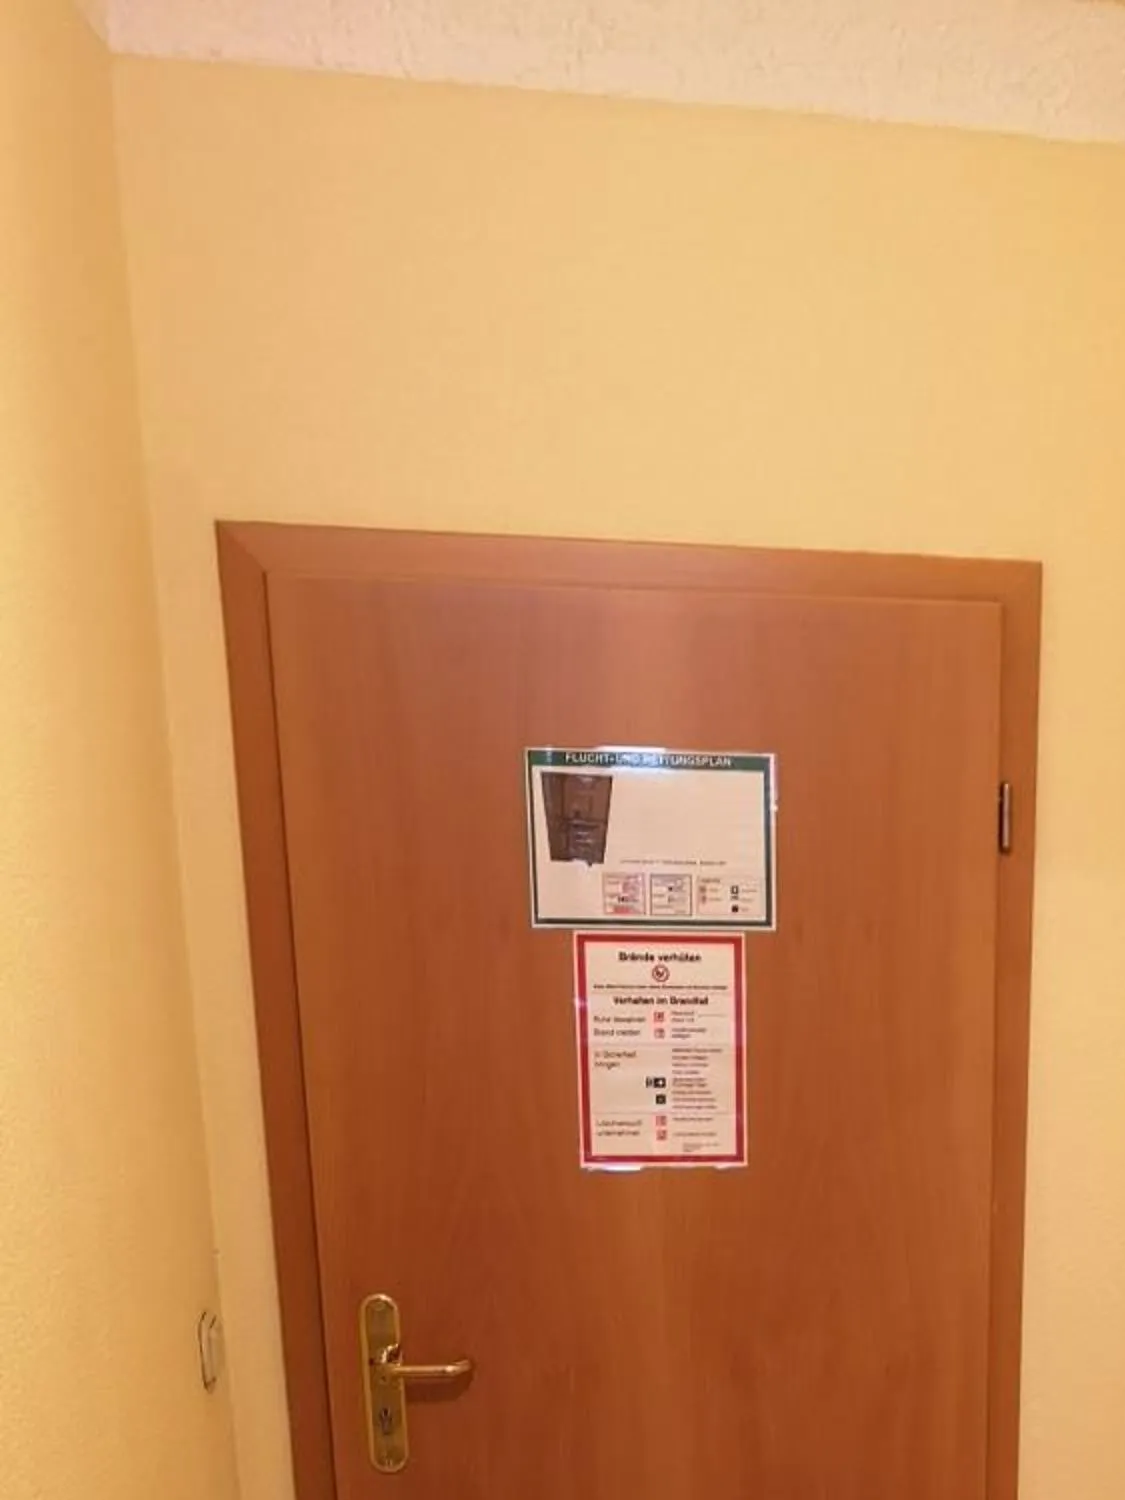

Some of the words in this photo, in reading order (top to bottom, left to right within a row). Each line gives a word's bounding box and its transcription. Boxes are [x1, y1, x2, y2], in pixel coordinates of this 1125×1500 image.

[618, 952, 654, 961] Brände
[658, 953, 702, 961] verhüten
[613, 996, 654, 1005] Verhalten
[656, 997, 668, 1005] im
[670, 996, 708, 1005] Brandfall
